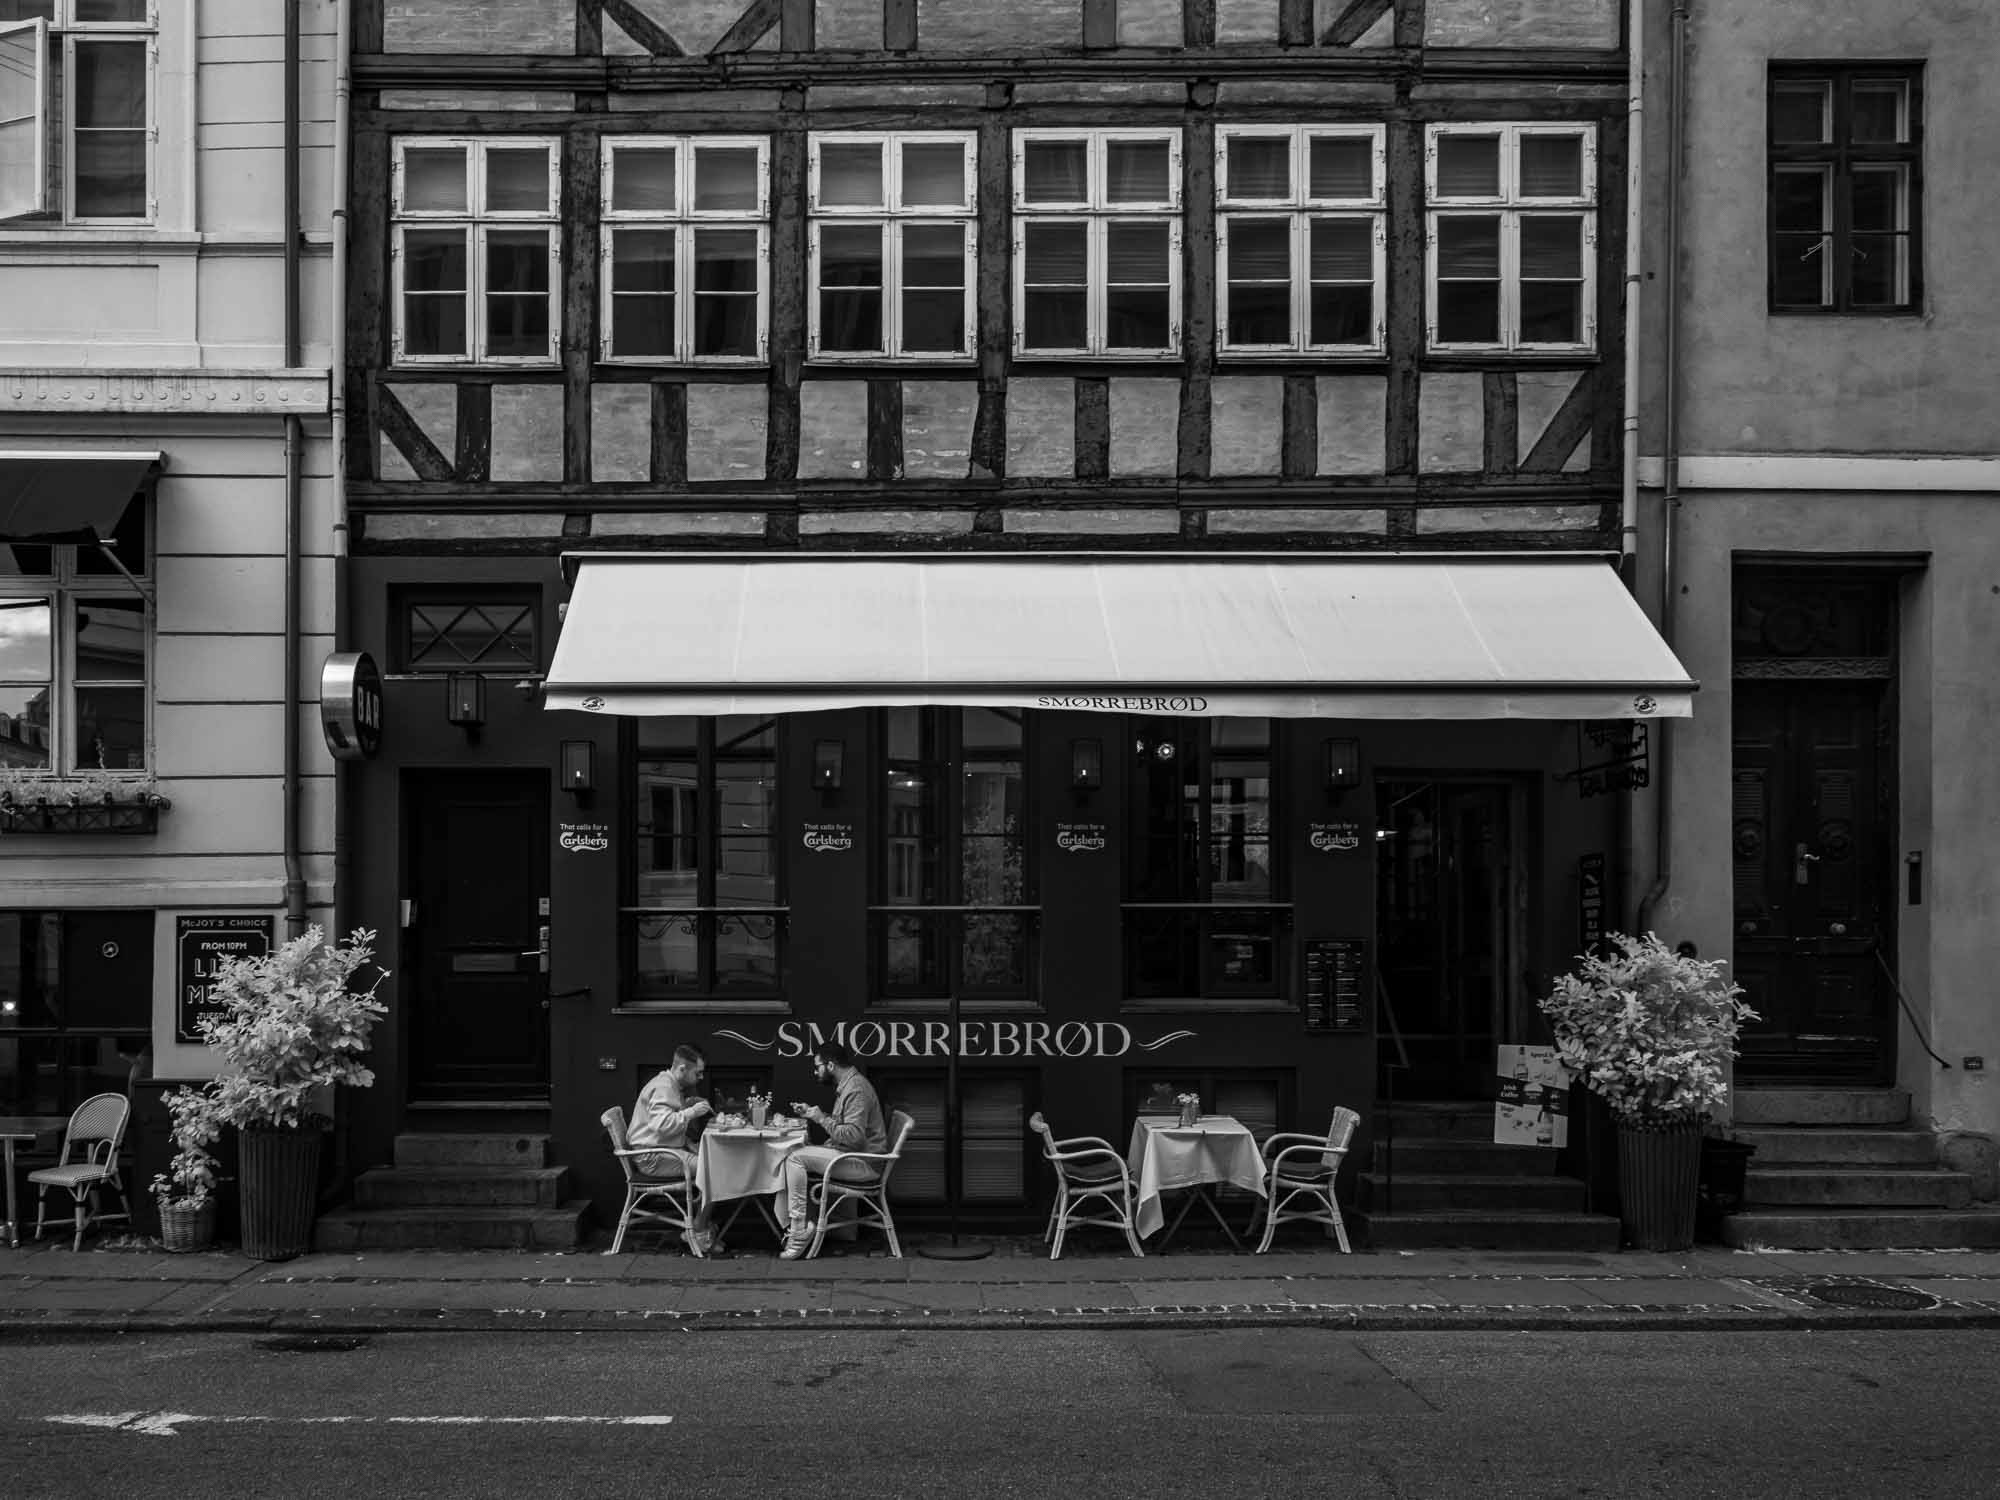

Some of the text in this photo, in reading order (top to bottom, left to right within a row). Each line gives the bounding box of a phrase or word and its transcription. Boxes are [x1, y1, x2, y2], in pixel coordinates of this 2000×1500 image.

[357, 684, 380, 729] BAR
[1037, 695, 1208, 713] SMØRREBRØD
[559, 831, 608, 852] Carlsberg
[803, 831, 852, 852] Carlsberg
[1056, 831, 1105, 852] Carlsberg
[1310, 831, 1359, 852] Carlsberg
[229, 919, 268, 927] CHOICE
[200, 941, 226, 950] FROM
[776, 1018, 1132, 1059] SMØRREBRØD
